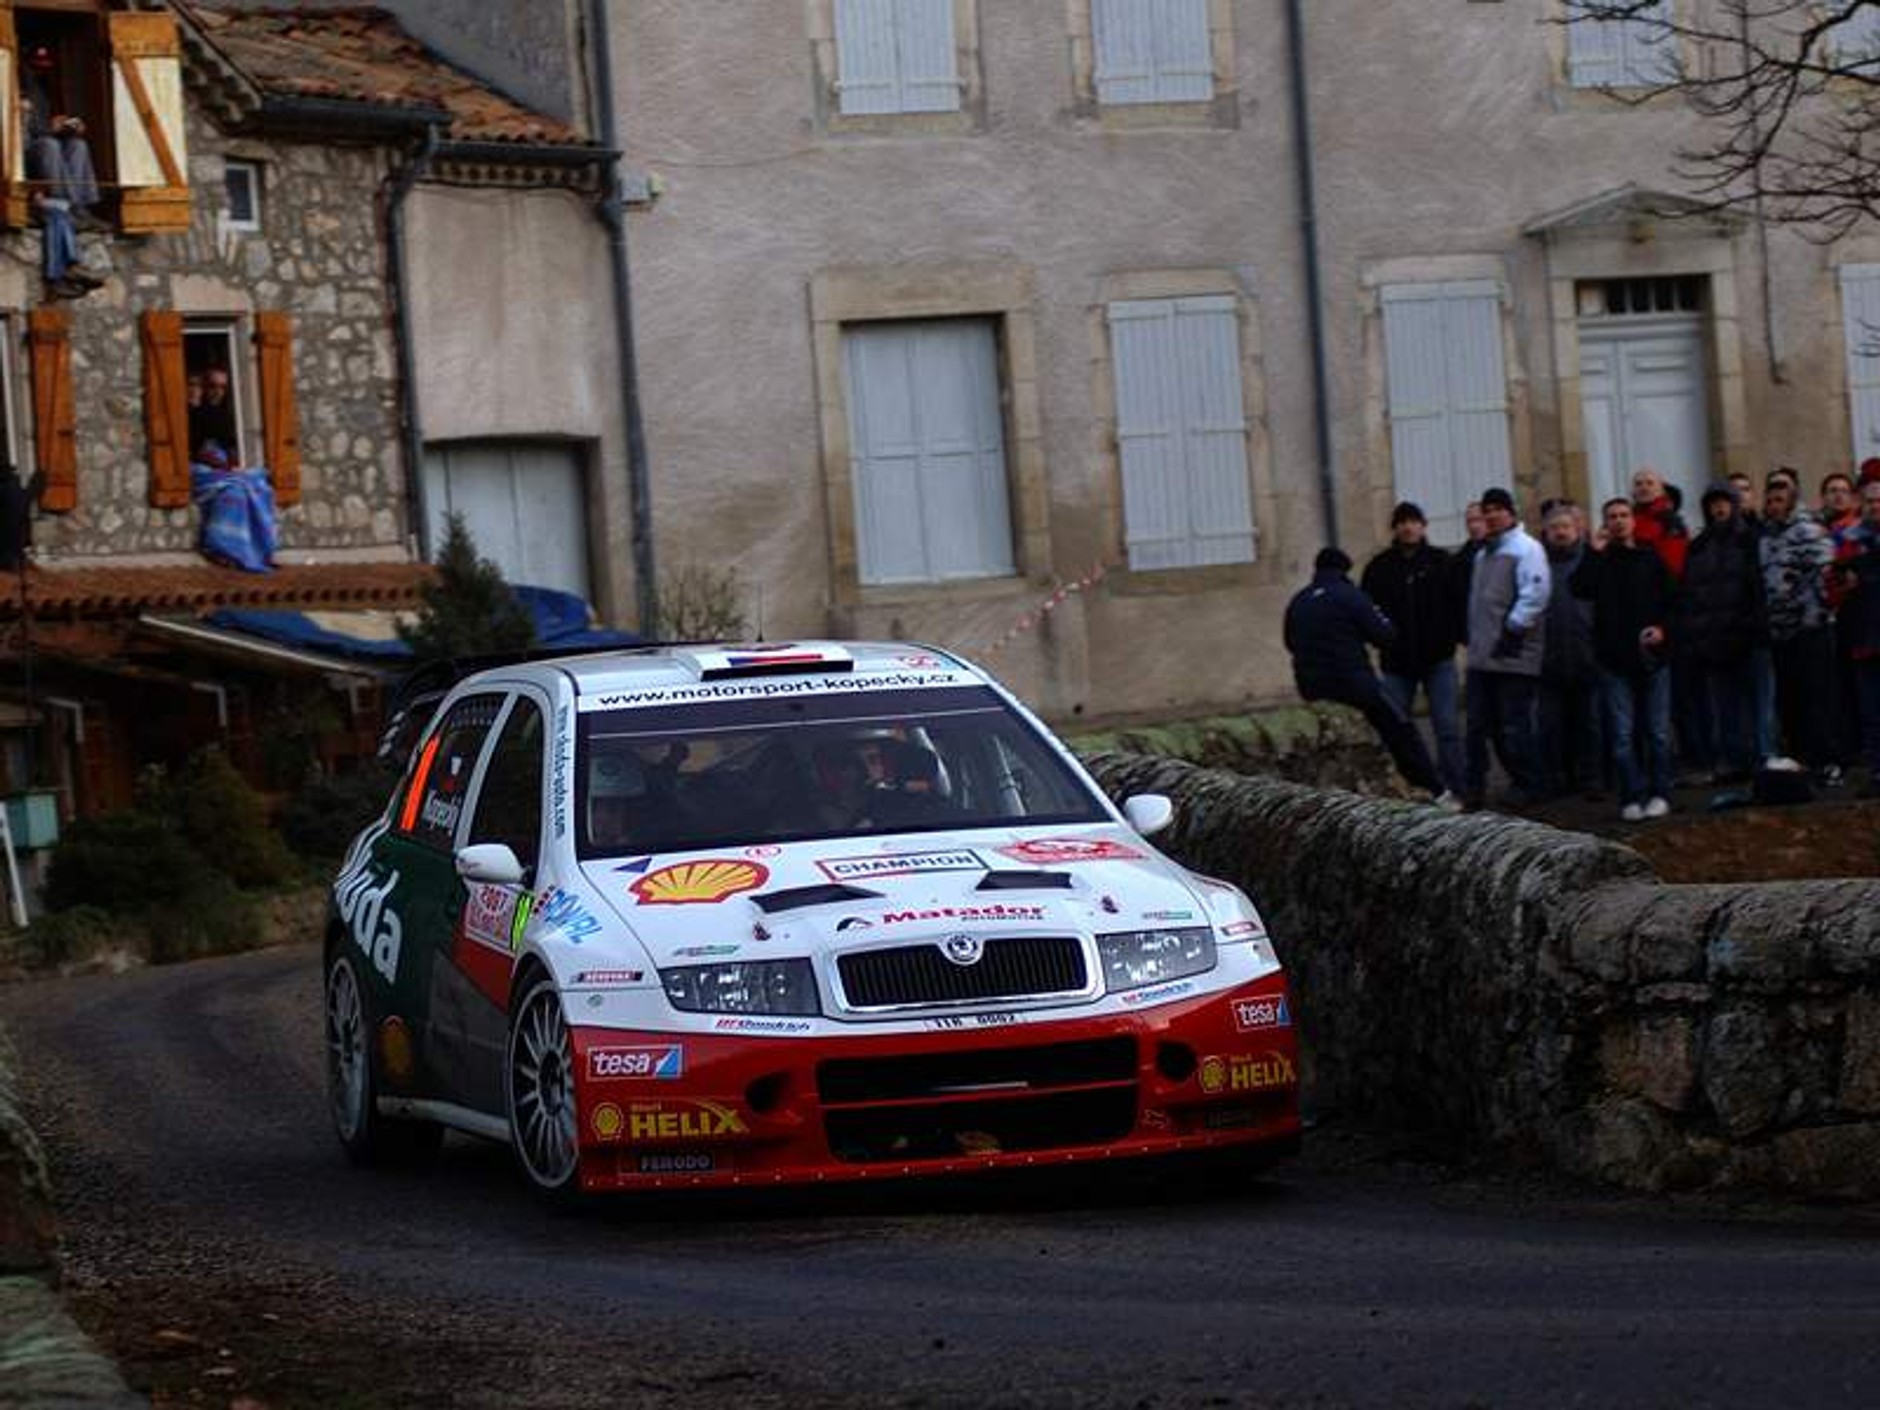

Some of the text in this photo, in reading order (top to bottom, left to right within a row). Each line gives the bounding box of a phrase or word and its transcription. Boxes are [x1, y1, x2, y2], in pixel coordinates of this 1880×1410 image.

[598, 671, 960, 706] www.motorsport-kopecky.cz
[833, 854, 975, 875] CHAMPION
[882, 903, 1046, 925] Matador
[1237, 1002, 1276, 1026] tesa
[593, 1051, 651, 1076] tesa
[1231, 1055, 1296, 1090] HELIX
[630, 1102, 750, 1139] HELIX
